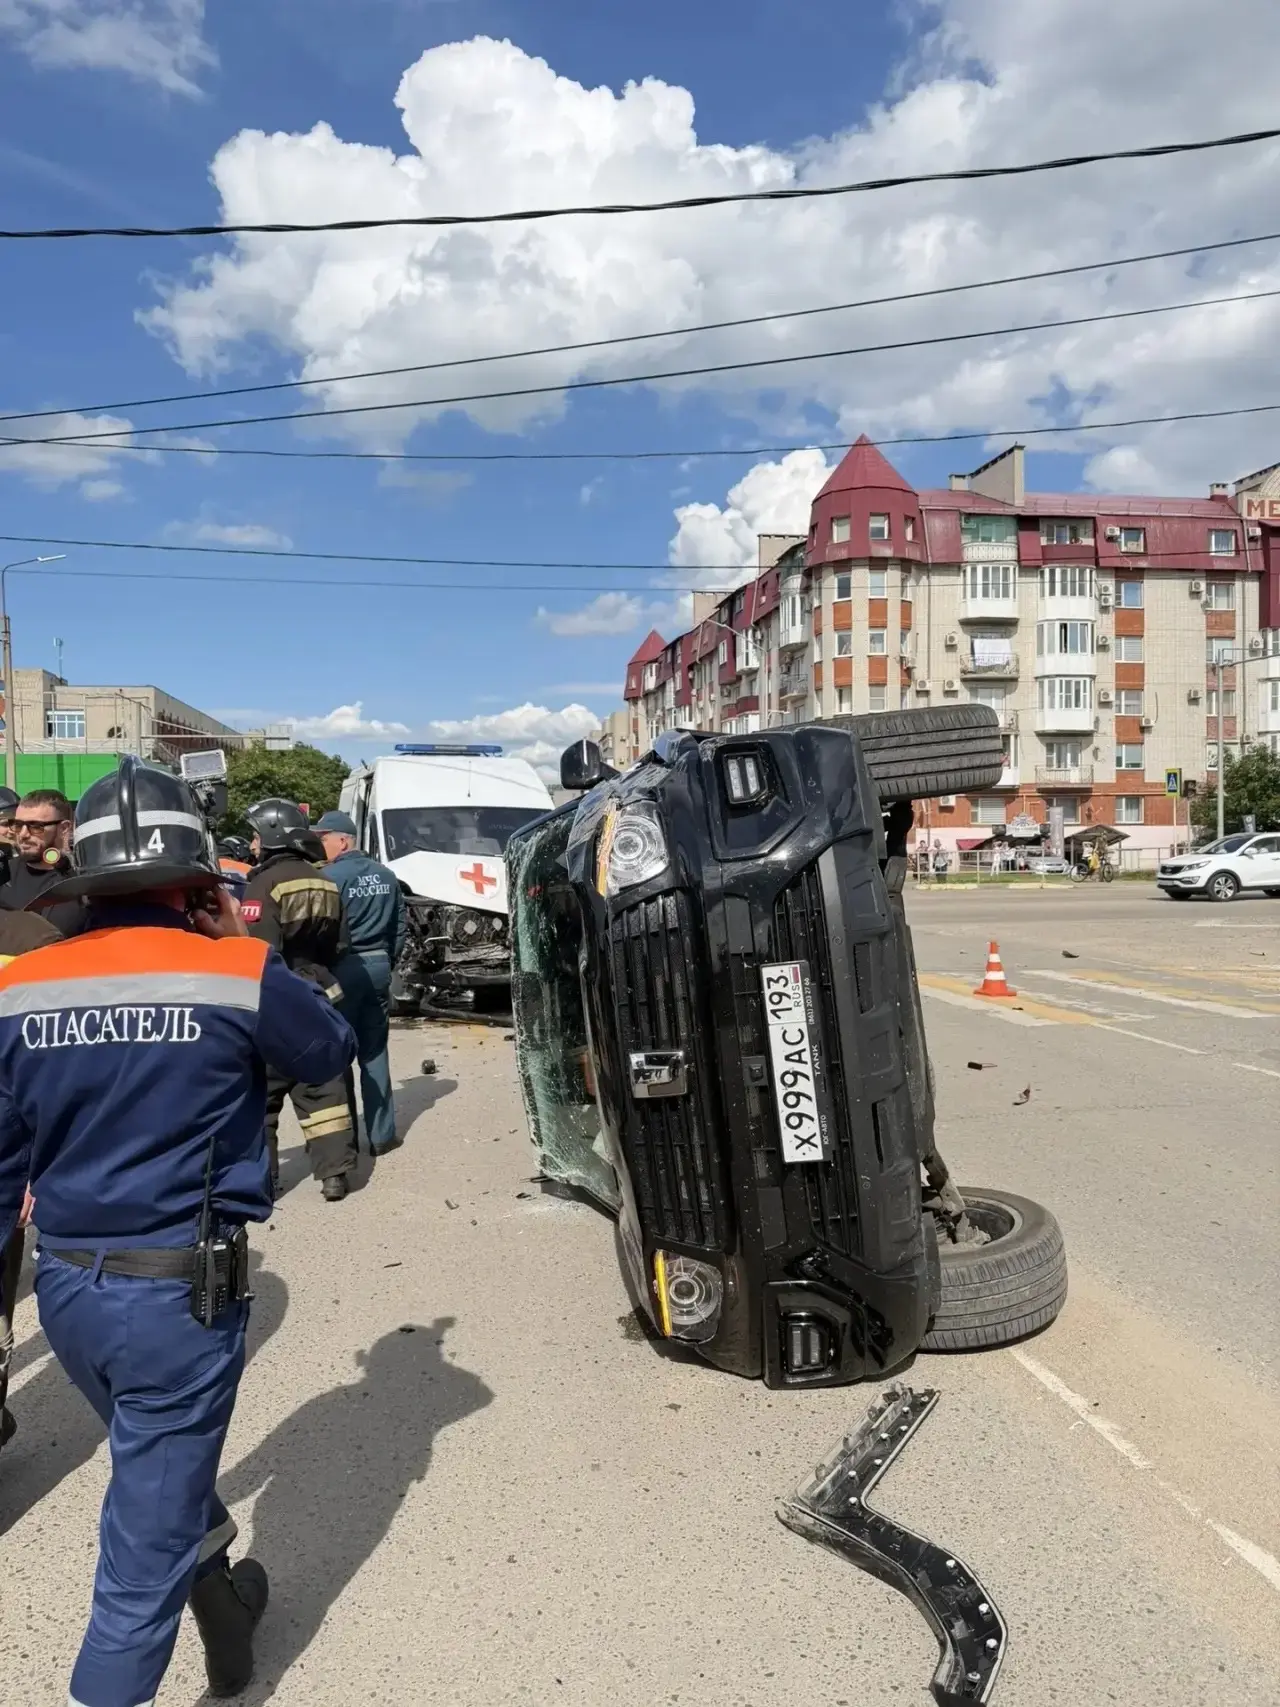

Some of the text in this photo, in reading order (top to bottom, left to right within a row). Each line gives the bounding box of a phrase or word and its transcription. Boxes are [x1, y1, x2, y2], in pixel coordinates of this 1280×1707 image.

[147, 828, 165, 854] 4
[348, 884, 391, 898] РОССИИ
[357, 874, 381, 886] МЧС
[792, 984, 802, 1008] RUS
[21, 1006, 202, 1050] СПАСАТЕЛЬ
[766, 975, 819, 1150] Х999АС 193
[811, 1044, 821, 1077] TANK
[820, 1114, 829, 1145] ЮГ-АВТО
